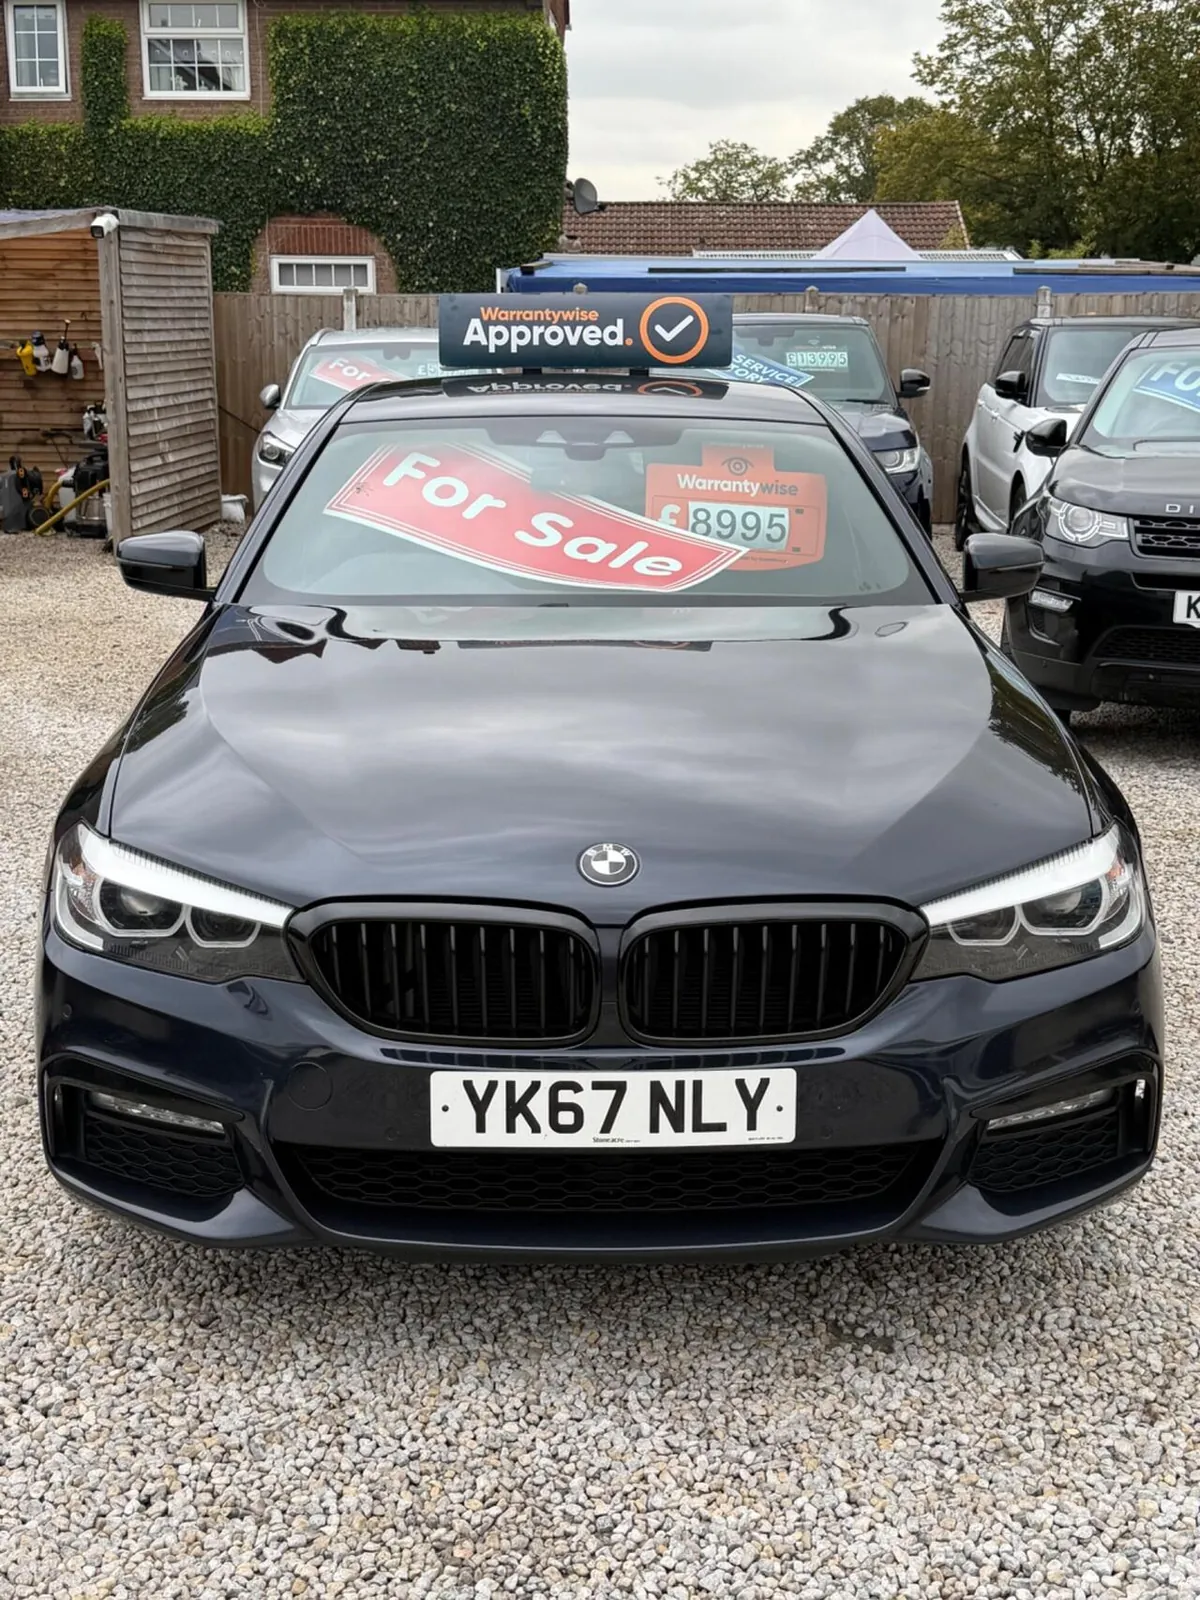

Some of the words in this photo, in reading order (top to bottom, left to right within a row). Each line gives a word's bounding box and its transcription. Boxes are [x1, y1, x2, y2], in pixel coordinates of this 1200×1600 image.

[480, 307, 599, 324] Warrantywise
[463, 318, 633, 353] Approved.
[328, 358, 372, 381] For
[733, 354, 799, 384] SERVICE
[787, 352, 847, 367] £13995
[1149, 361, 1200, 397] FO
[677, 474, 799, 497] Warrantywise
[382, 451, 507, 520] For
[514, 511, 683, 577] Sale
[462, 1079, 628, 1135] YK67
[649, 1077, 771, 1134] NLY
